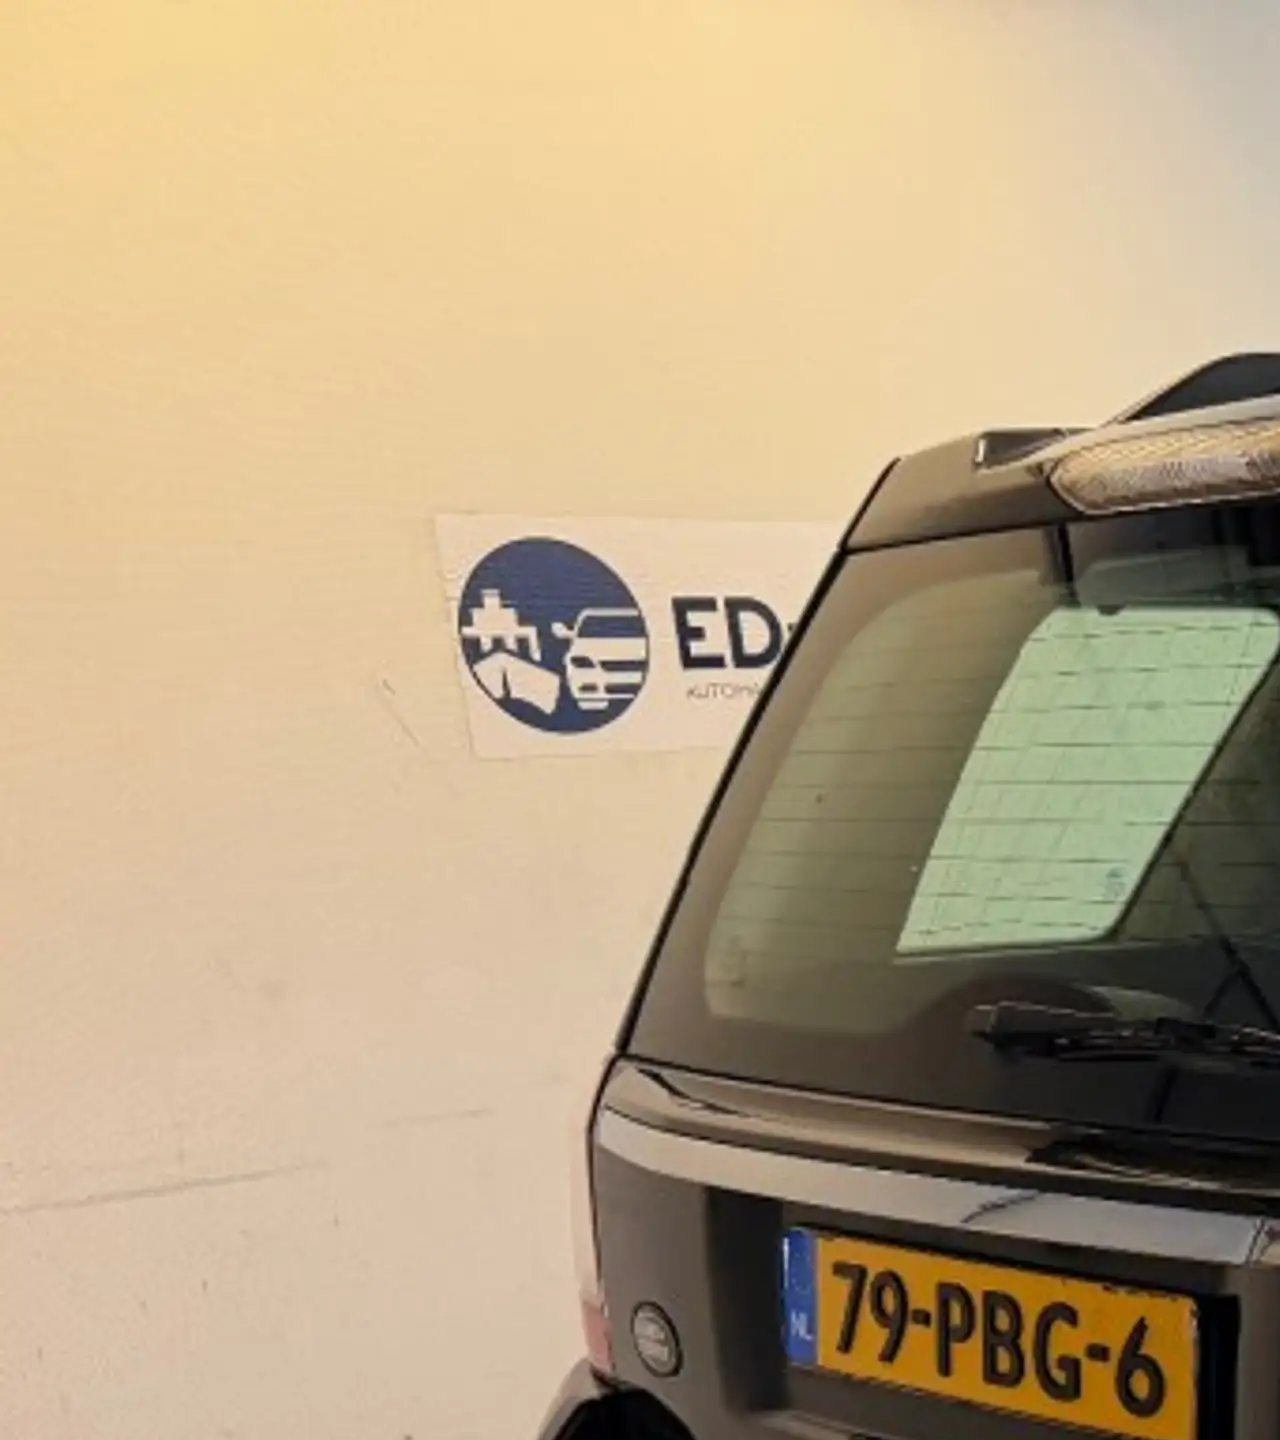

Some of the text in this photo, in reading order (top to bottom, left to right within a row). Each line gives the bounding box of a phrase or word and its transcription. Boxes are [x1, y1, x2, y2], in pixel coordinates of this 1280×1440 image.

[671, 596, 798, 669] ED
[790, 1310, 814, 1342] NL
[832, 1260, 1167, 1418] 79-PBG-6
